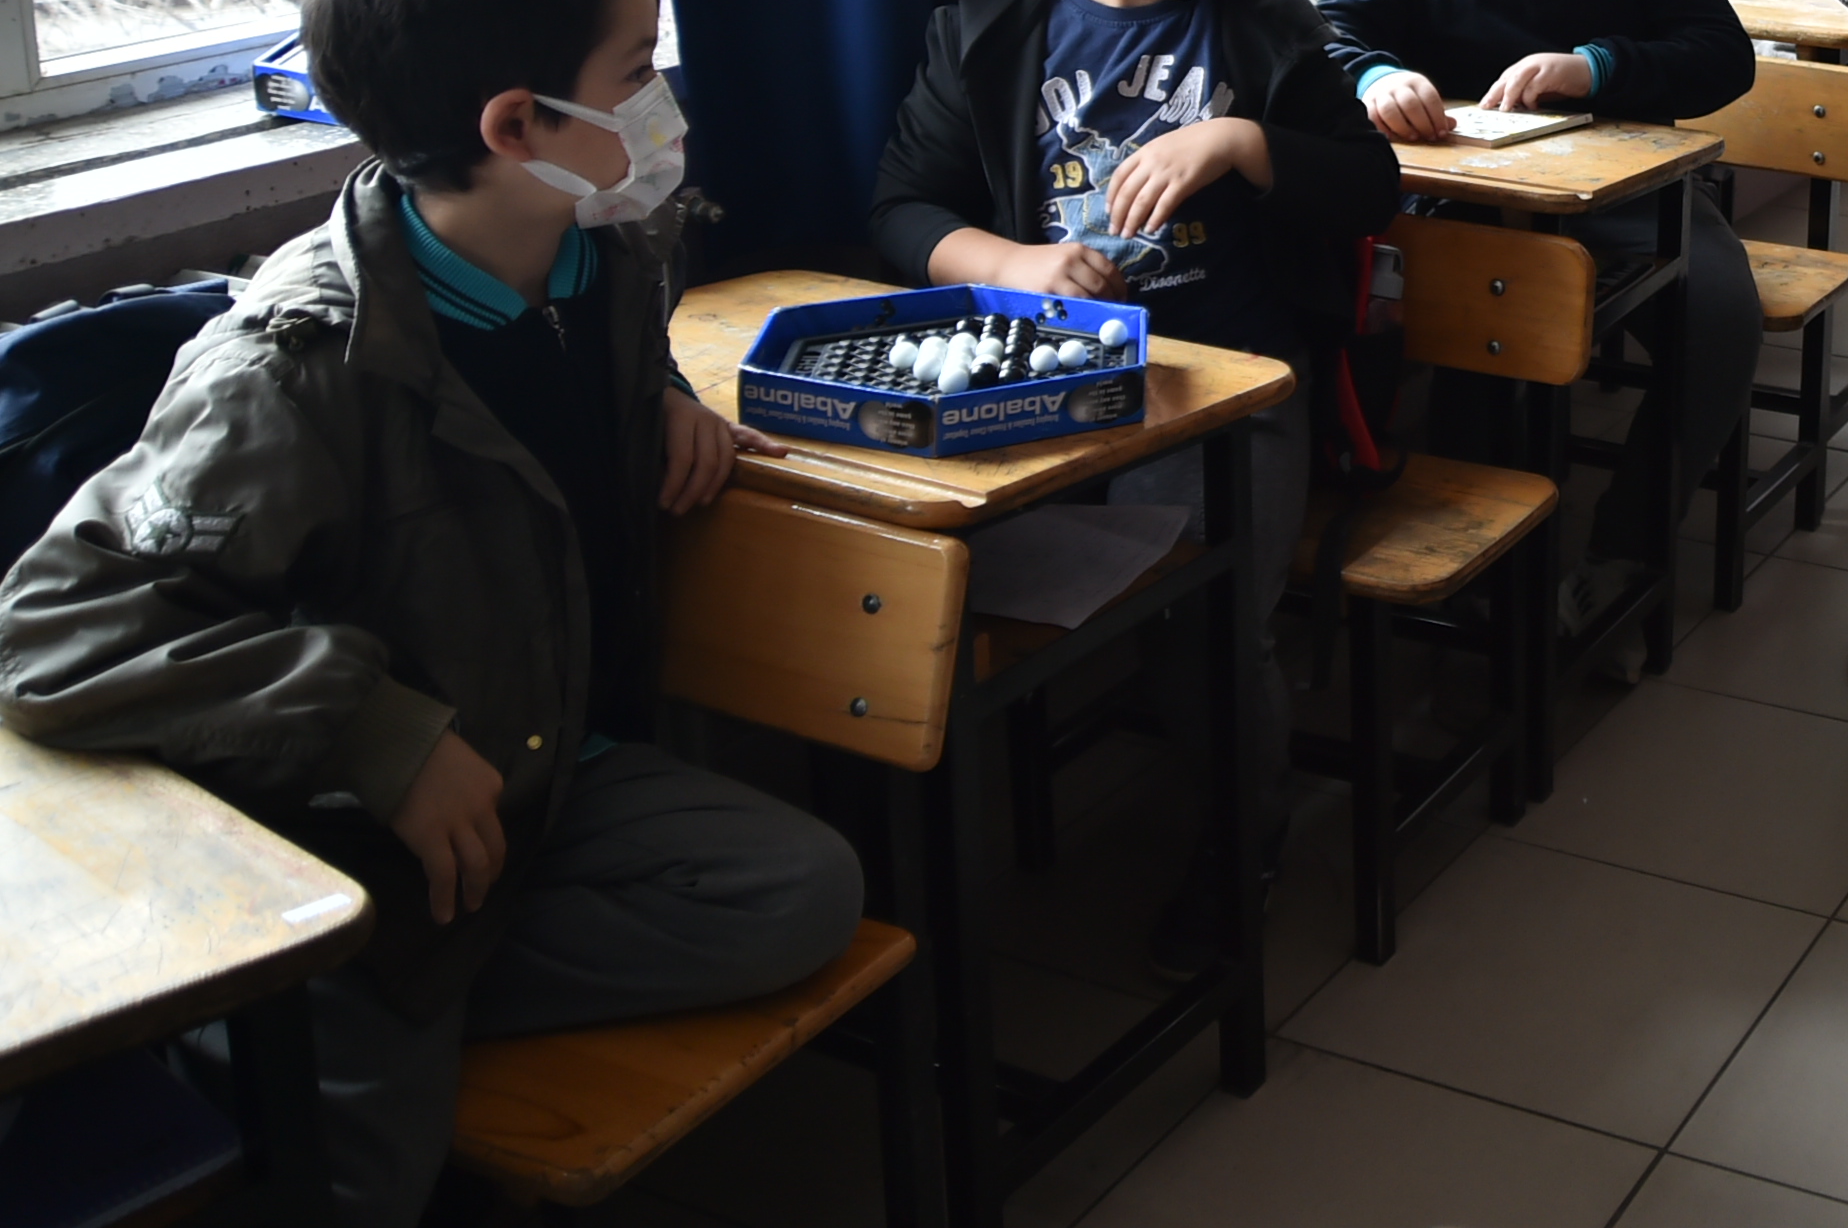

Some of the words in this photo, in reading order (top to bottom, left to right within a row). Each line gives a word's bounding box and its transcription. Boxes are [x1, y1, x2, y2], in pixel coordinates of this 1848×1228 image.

[1050, 160, 1085, 189] 19
[1172, 221, 1207, 248] 99
[744, 383, 857, 419] Abalone
[941, 391, 1067, 426] Abalone
